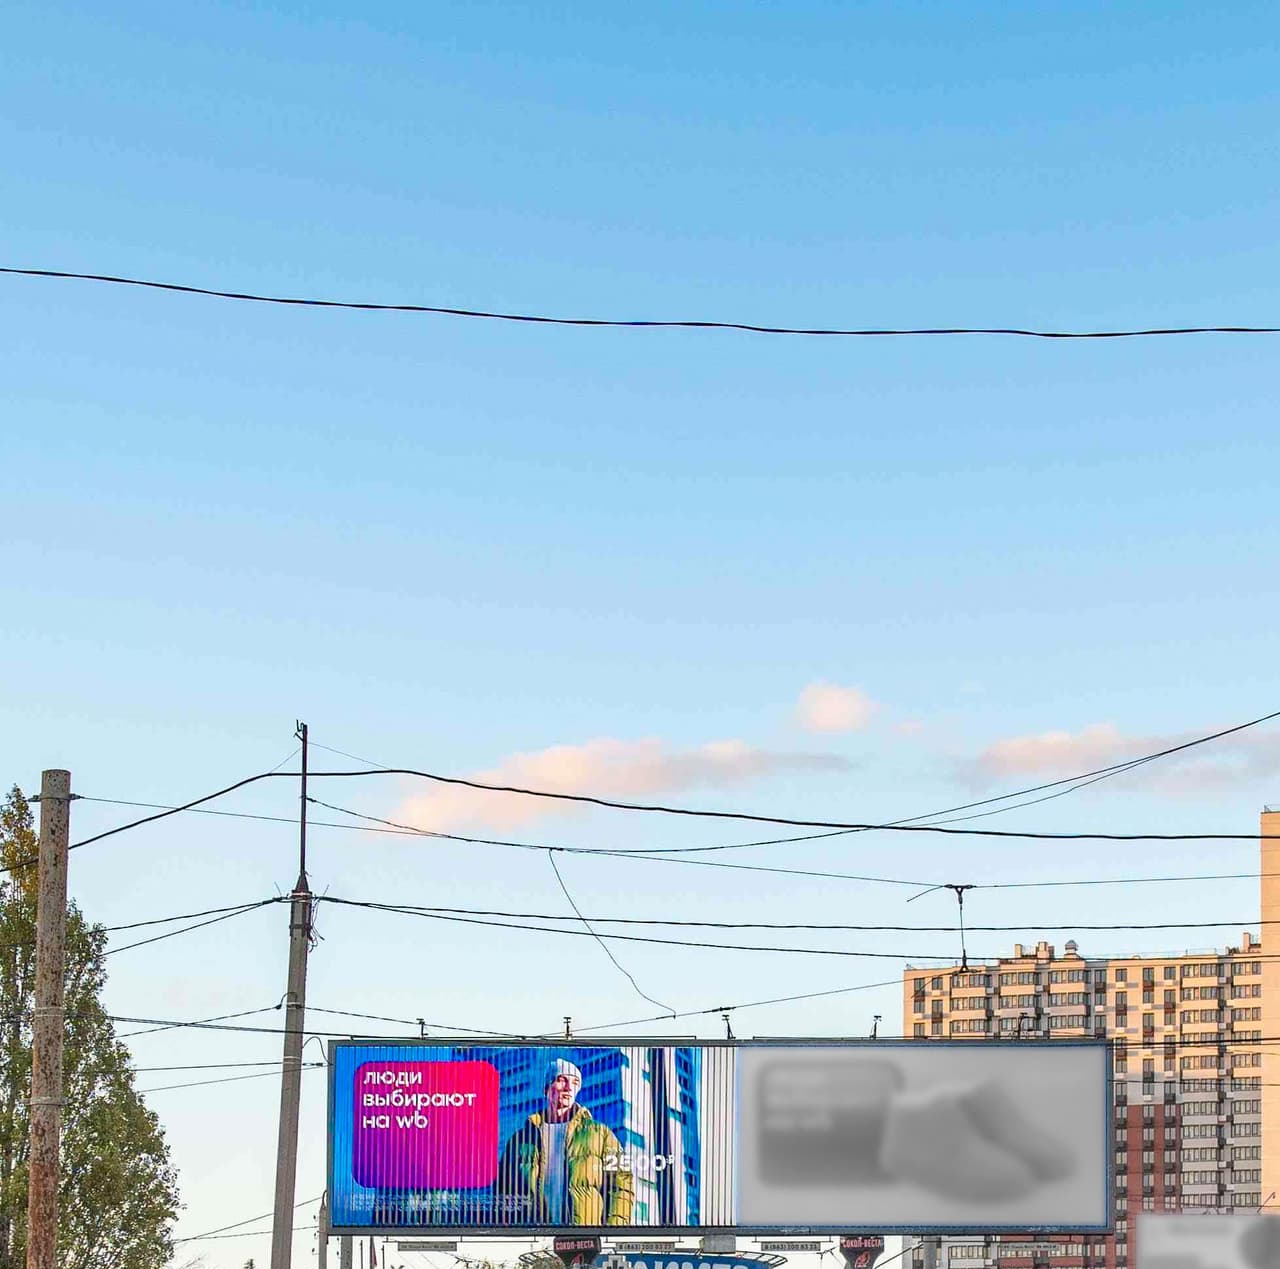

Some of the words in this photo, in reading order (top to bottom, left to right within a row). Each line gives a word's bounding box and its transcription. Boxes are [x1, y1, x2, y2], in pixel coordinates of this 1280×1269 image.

[363, 1071, 422, 1087] люди
[363, 1089, 477, 1111] выбирают
[362, 1115, 390, 1128] на
[395, 1110, 428, 1128] wb
